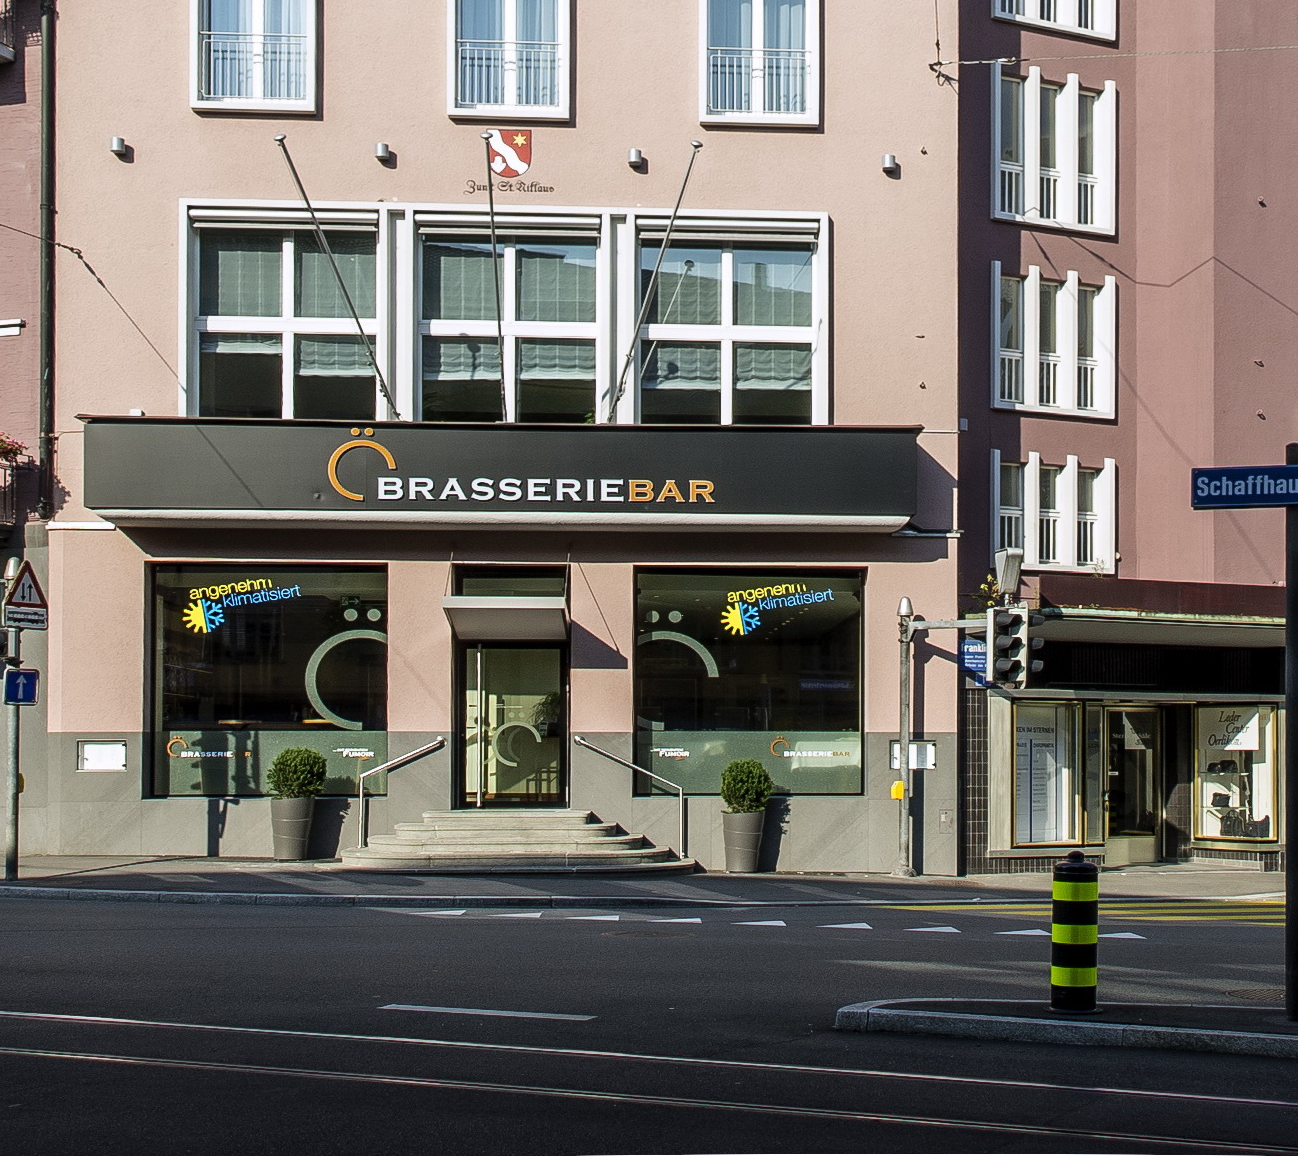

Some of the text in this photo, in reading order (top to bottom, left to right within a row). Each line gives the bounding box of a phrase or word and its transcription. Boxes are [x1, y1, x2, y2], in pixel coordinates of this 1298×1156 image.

[463, 179, 494, 195] Zunt
[189, 578, 273, 600] angenehm
[222, 584, 302, 608] klimatisiert
[758, 588, 835, 611] klimatisiert
